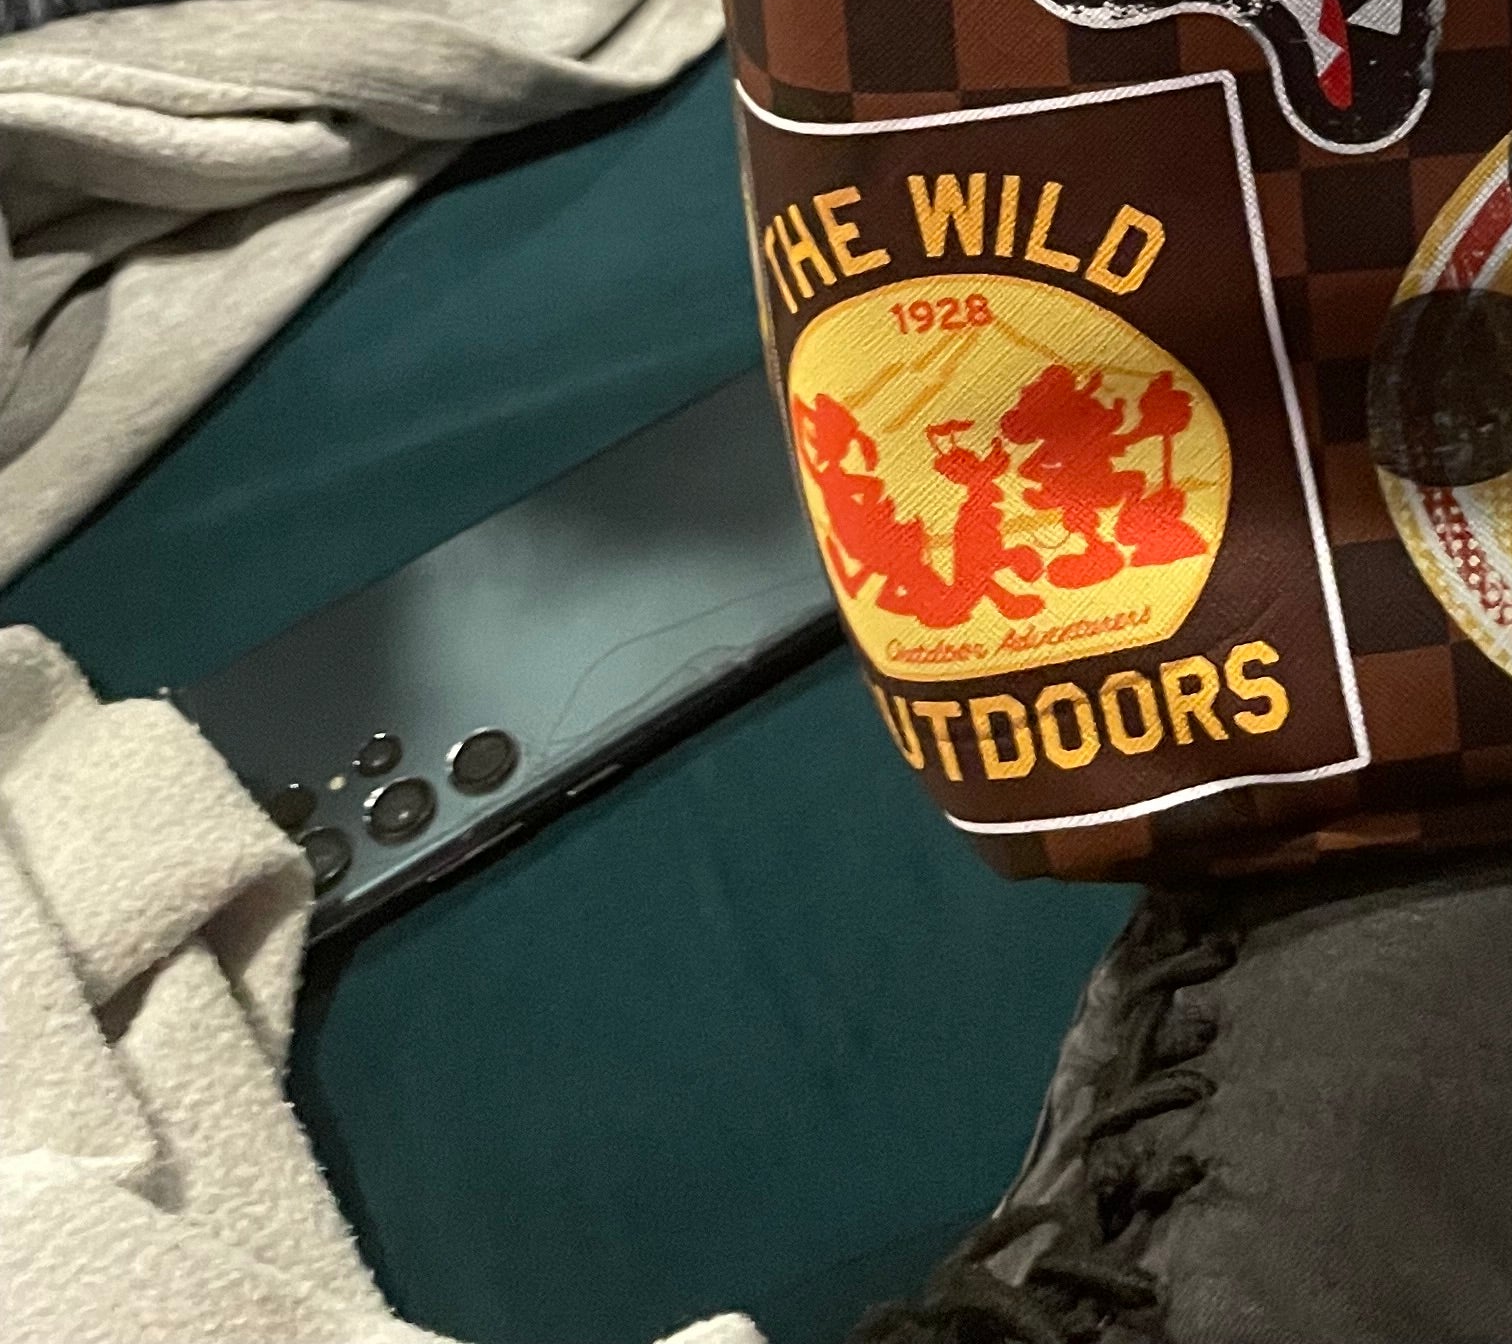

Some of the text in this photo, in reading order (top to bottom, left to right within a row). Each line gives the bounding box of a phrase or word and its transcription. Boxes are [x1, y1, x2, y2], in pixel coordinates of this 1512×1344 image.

[906, 171, 1168, 296] WILD
[889, 292, 993, 337] 1928
[872, 639, 1292, 784] UTDOORS
